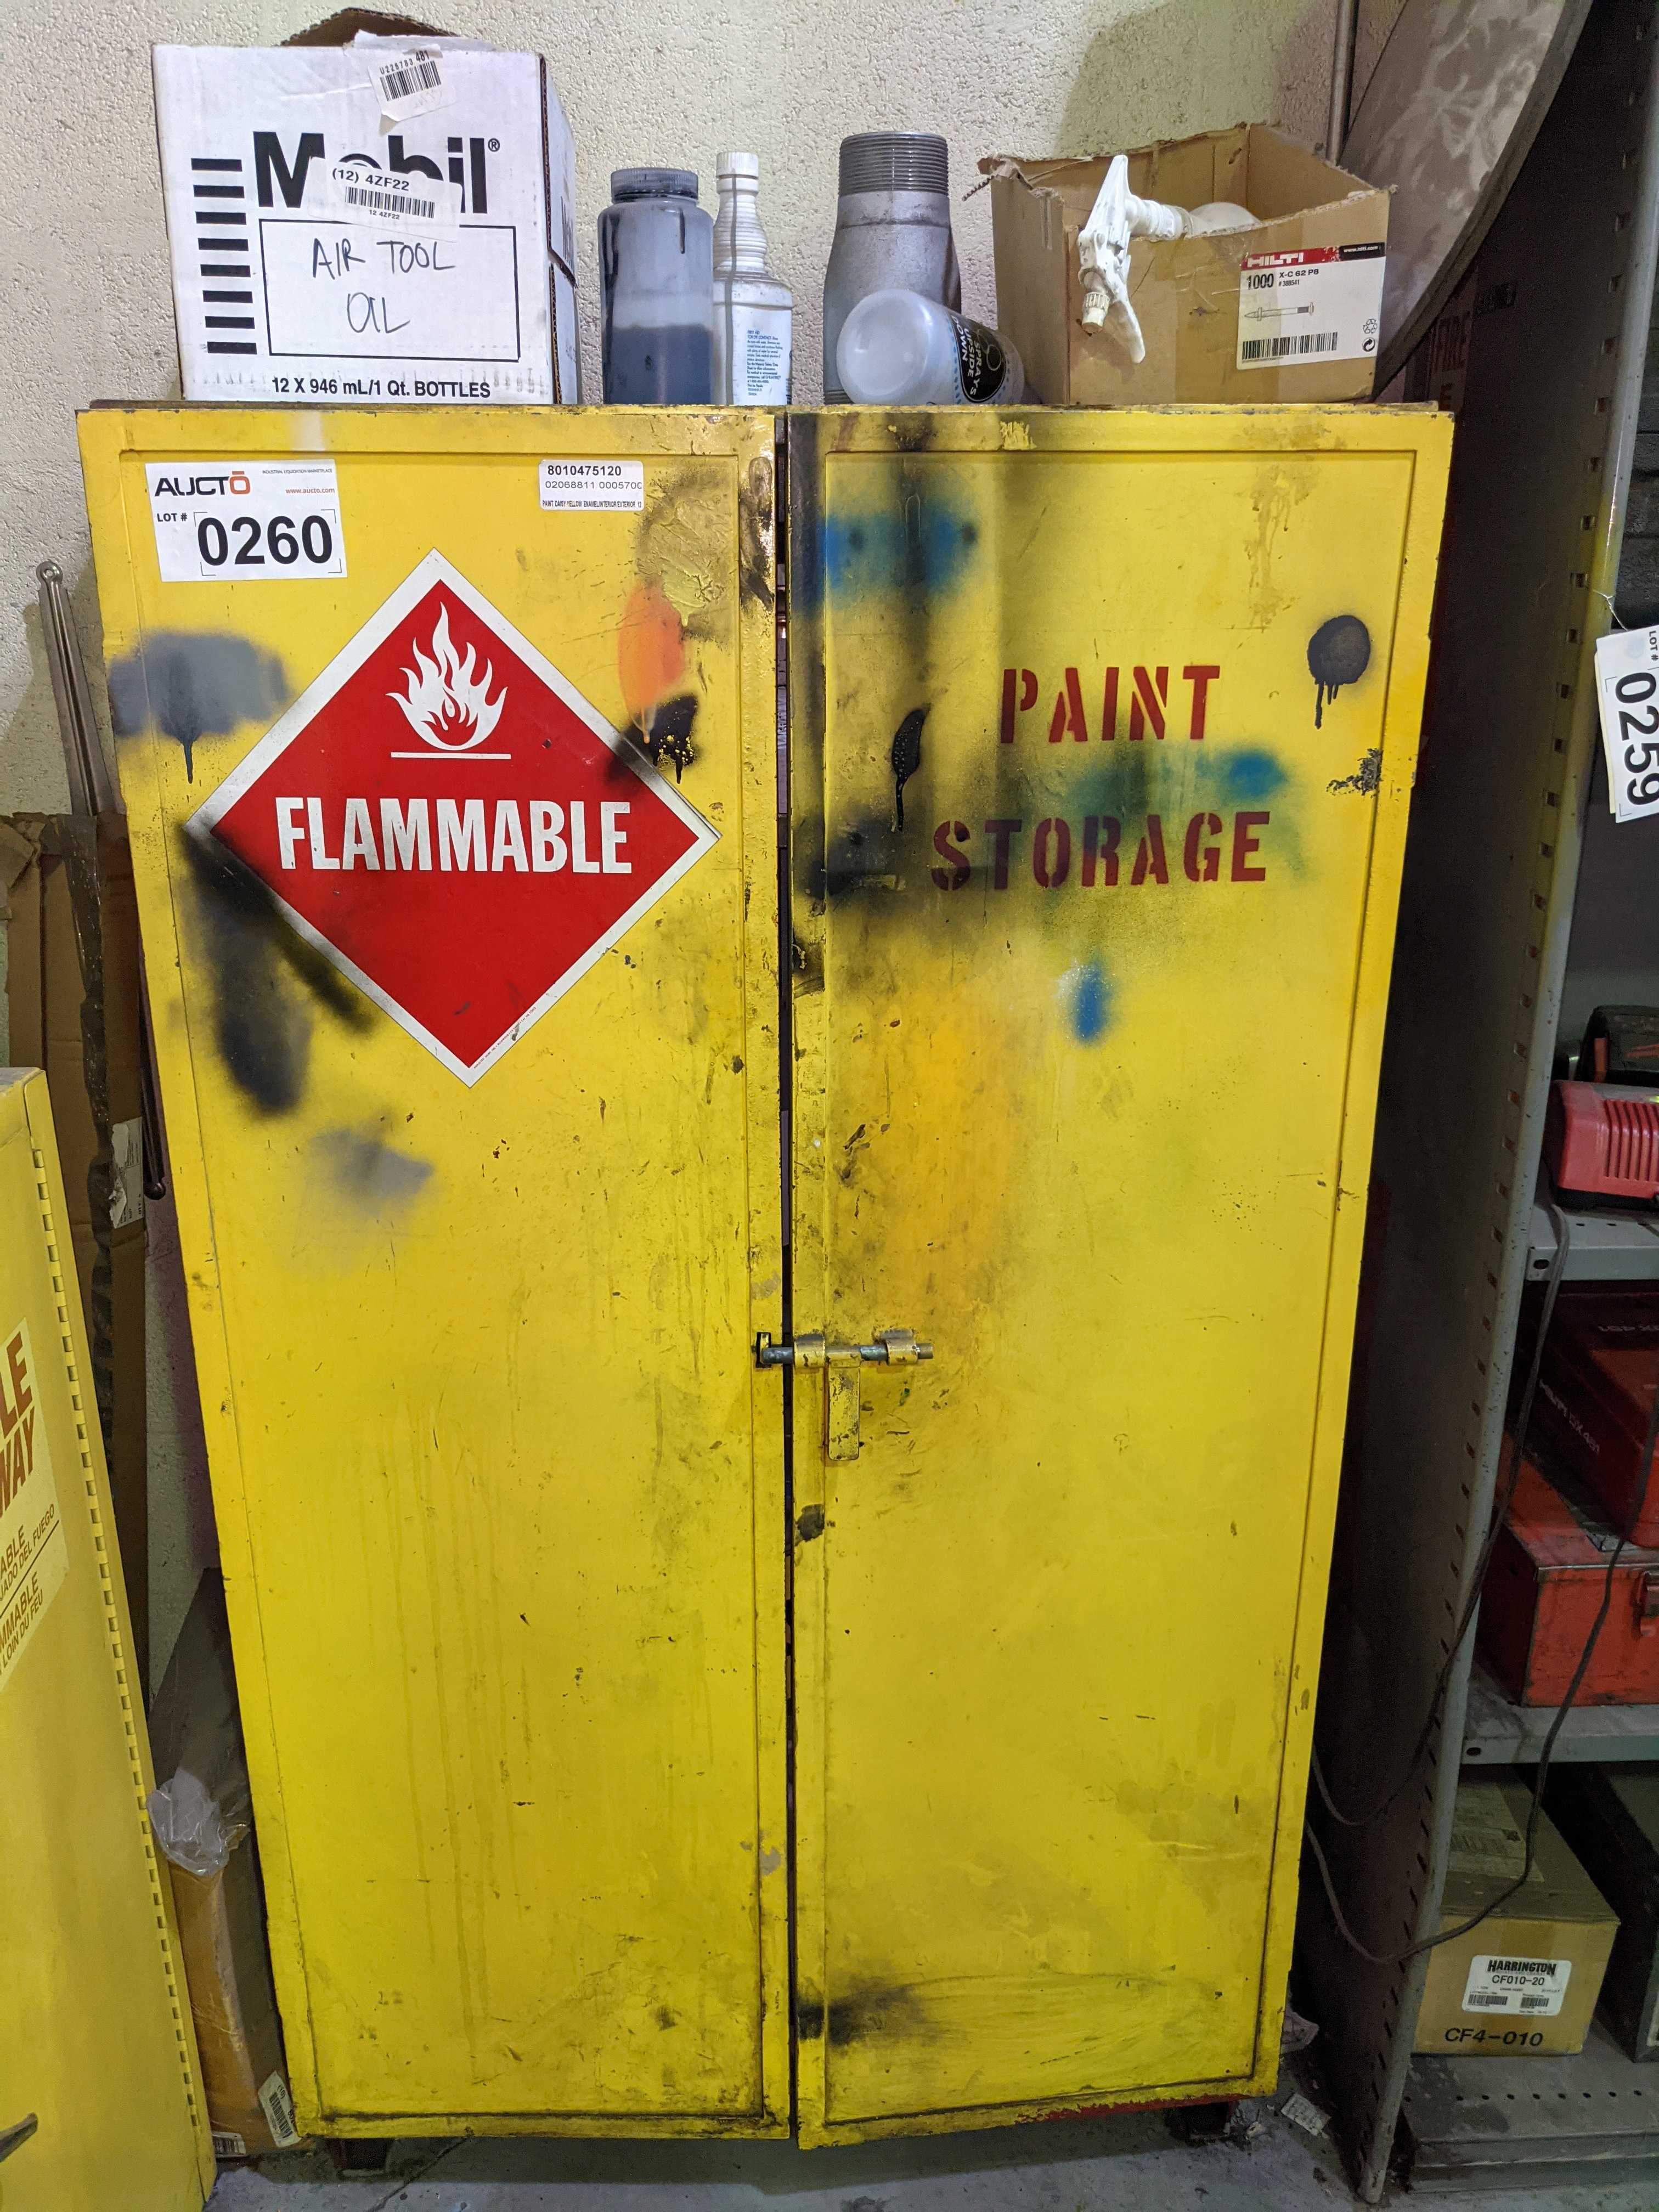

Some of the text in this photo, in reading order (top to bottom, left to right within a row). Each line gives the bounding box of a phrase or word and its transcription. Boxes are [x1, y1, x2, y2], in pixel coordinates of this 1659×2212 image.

[332, 168, 410, 191] (12) 4ZF22
[312, 238, 456, 280] AIR TOOL
[1247, 252, 1304, 268] HILTI
[1246, 273, 1274, 290] 1000
[951, 315, 968, 362] DOWN
[964, 328, 975, 378] UPSIDE
[272, 377, 491, 398] 12 X 946 mL/1 Qt. BOTTLES
[970, 340, 983, 396] SPRAYS
[545, 481, 595, 489] 02068811
[548, 465, 622, 476] 8010475120
[157, 513, 177, 522] LOT
[198, 515, 332, 566] 0260
[1649, 630, 1658, 651] LOT
[1000, 664, 1221, 744] PAINT
[1615, 672, 1659, 805] 0259
[276, 797, 632, 873] FLAMMABLE
[929, 810, 1271, 891] STORAGE
[19, 1541, 32, 1570] DEL
[32, 1503, 55, 1547] FUEGO
[3, 1589, 43, 1668] LOIN DU FEU
[1487, 1960, 1557, 1975] HARRINGTON
[1492, 1975, 1545, 1986] CF010-20
[1445, 2028, 1543, 2046] CF4-010
